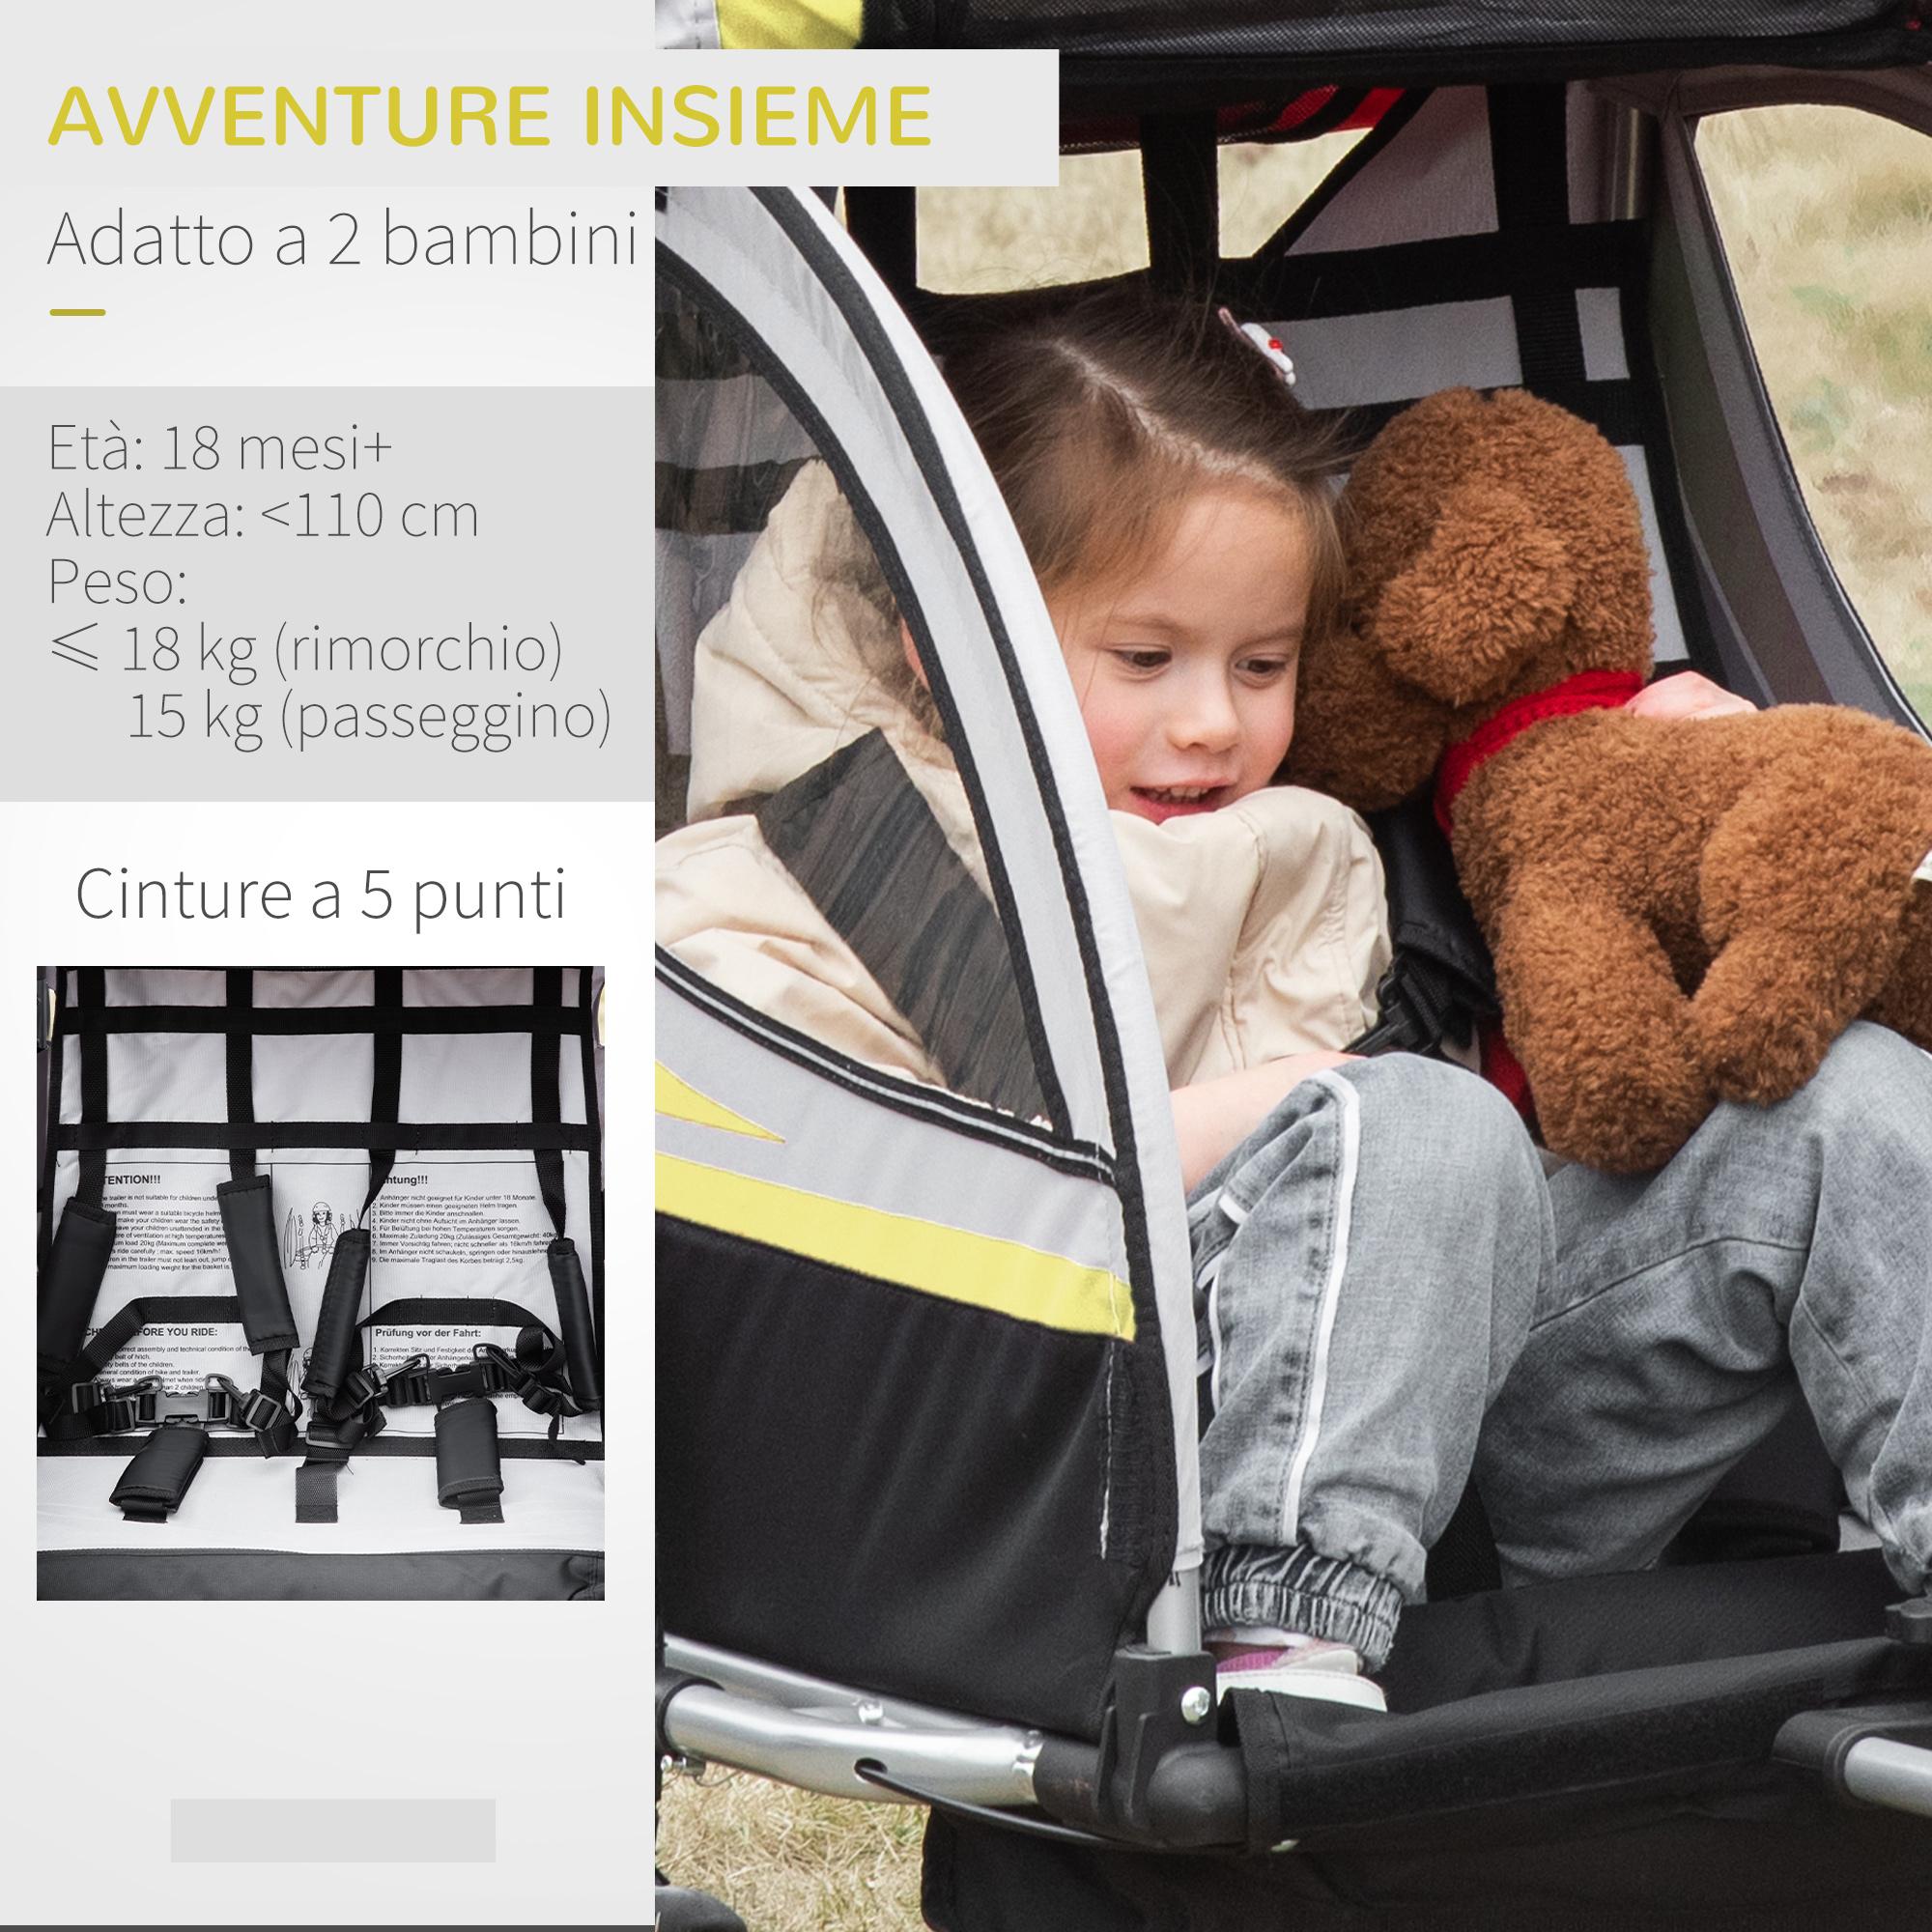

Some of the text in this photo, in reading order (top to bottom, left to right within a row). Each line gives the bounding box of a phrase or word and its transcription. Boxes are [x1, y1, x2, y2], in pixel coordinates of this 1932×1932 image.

[103, 1175, 160, 1184] ENTION!!!
[386, 1175, 428, 1186] htung!!!
[167, 1327, 188, 1336] YOU
[190, 1327, 217, 1336] RIDE:
[375, 1328, 482, 1339] Prüfung vor der Fahrt:
